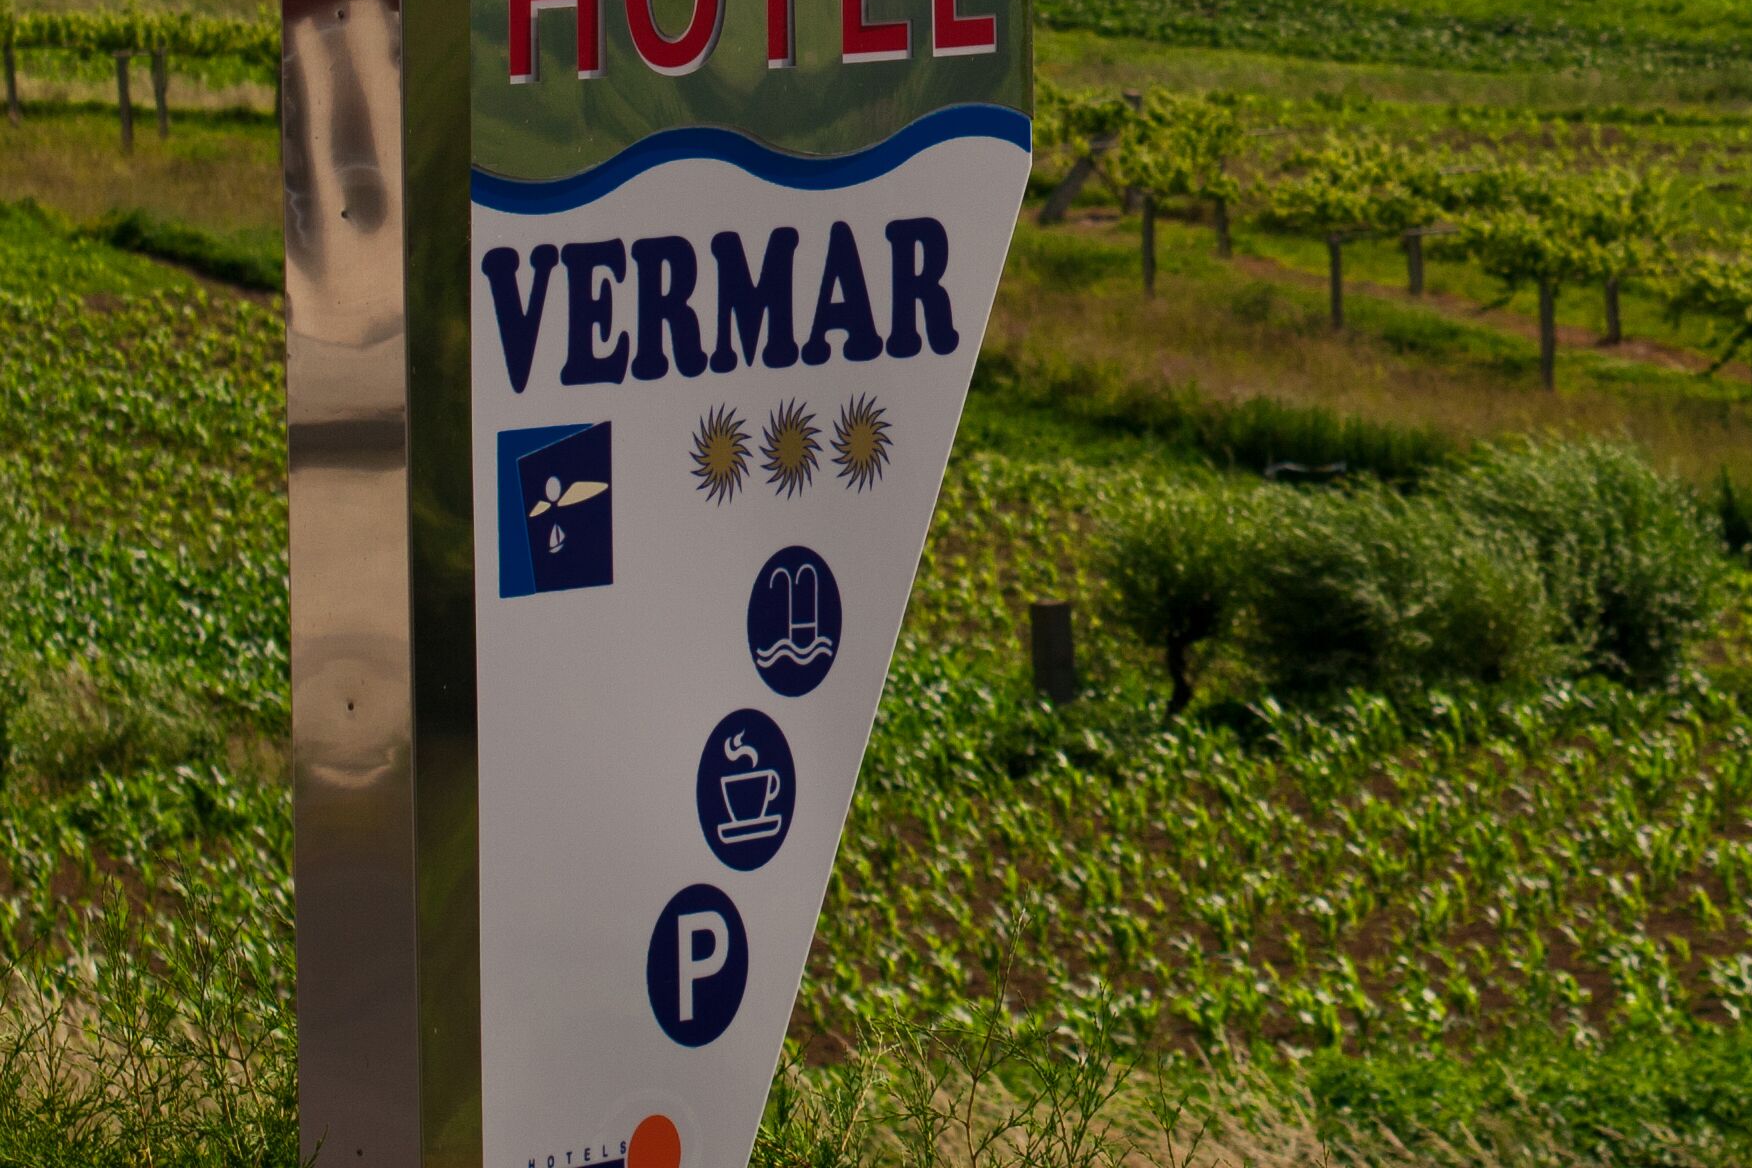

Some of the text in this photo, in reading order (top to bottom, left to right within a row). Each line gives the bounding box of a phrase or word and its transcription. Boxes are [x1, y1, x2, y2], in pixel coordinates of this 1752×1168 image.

[481, 217, 960, 394] VERMAR
[677, 909, 730, 1023] P
[528, 1140, 627, 1168] HOTELS
